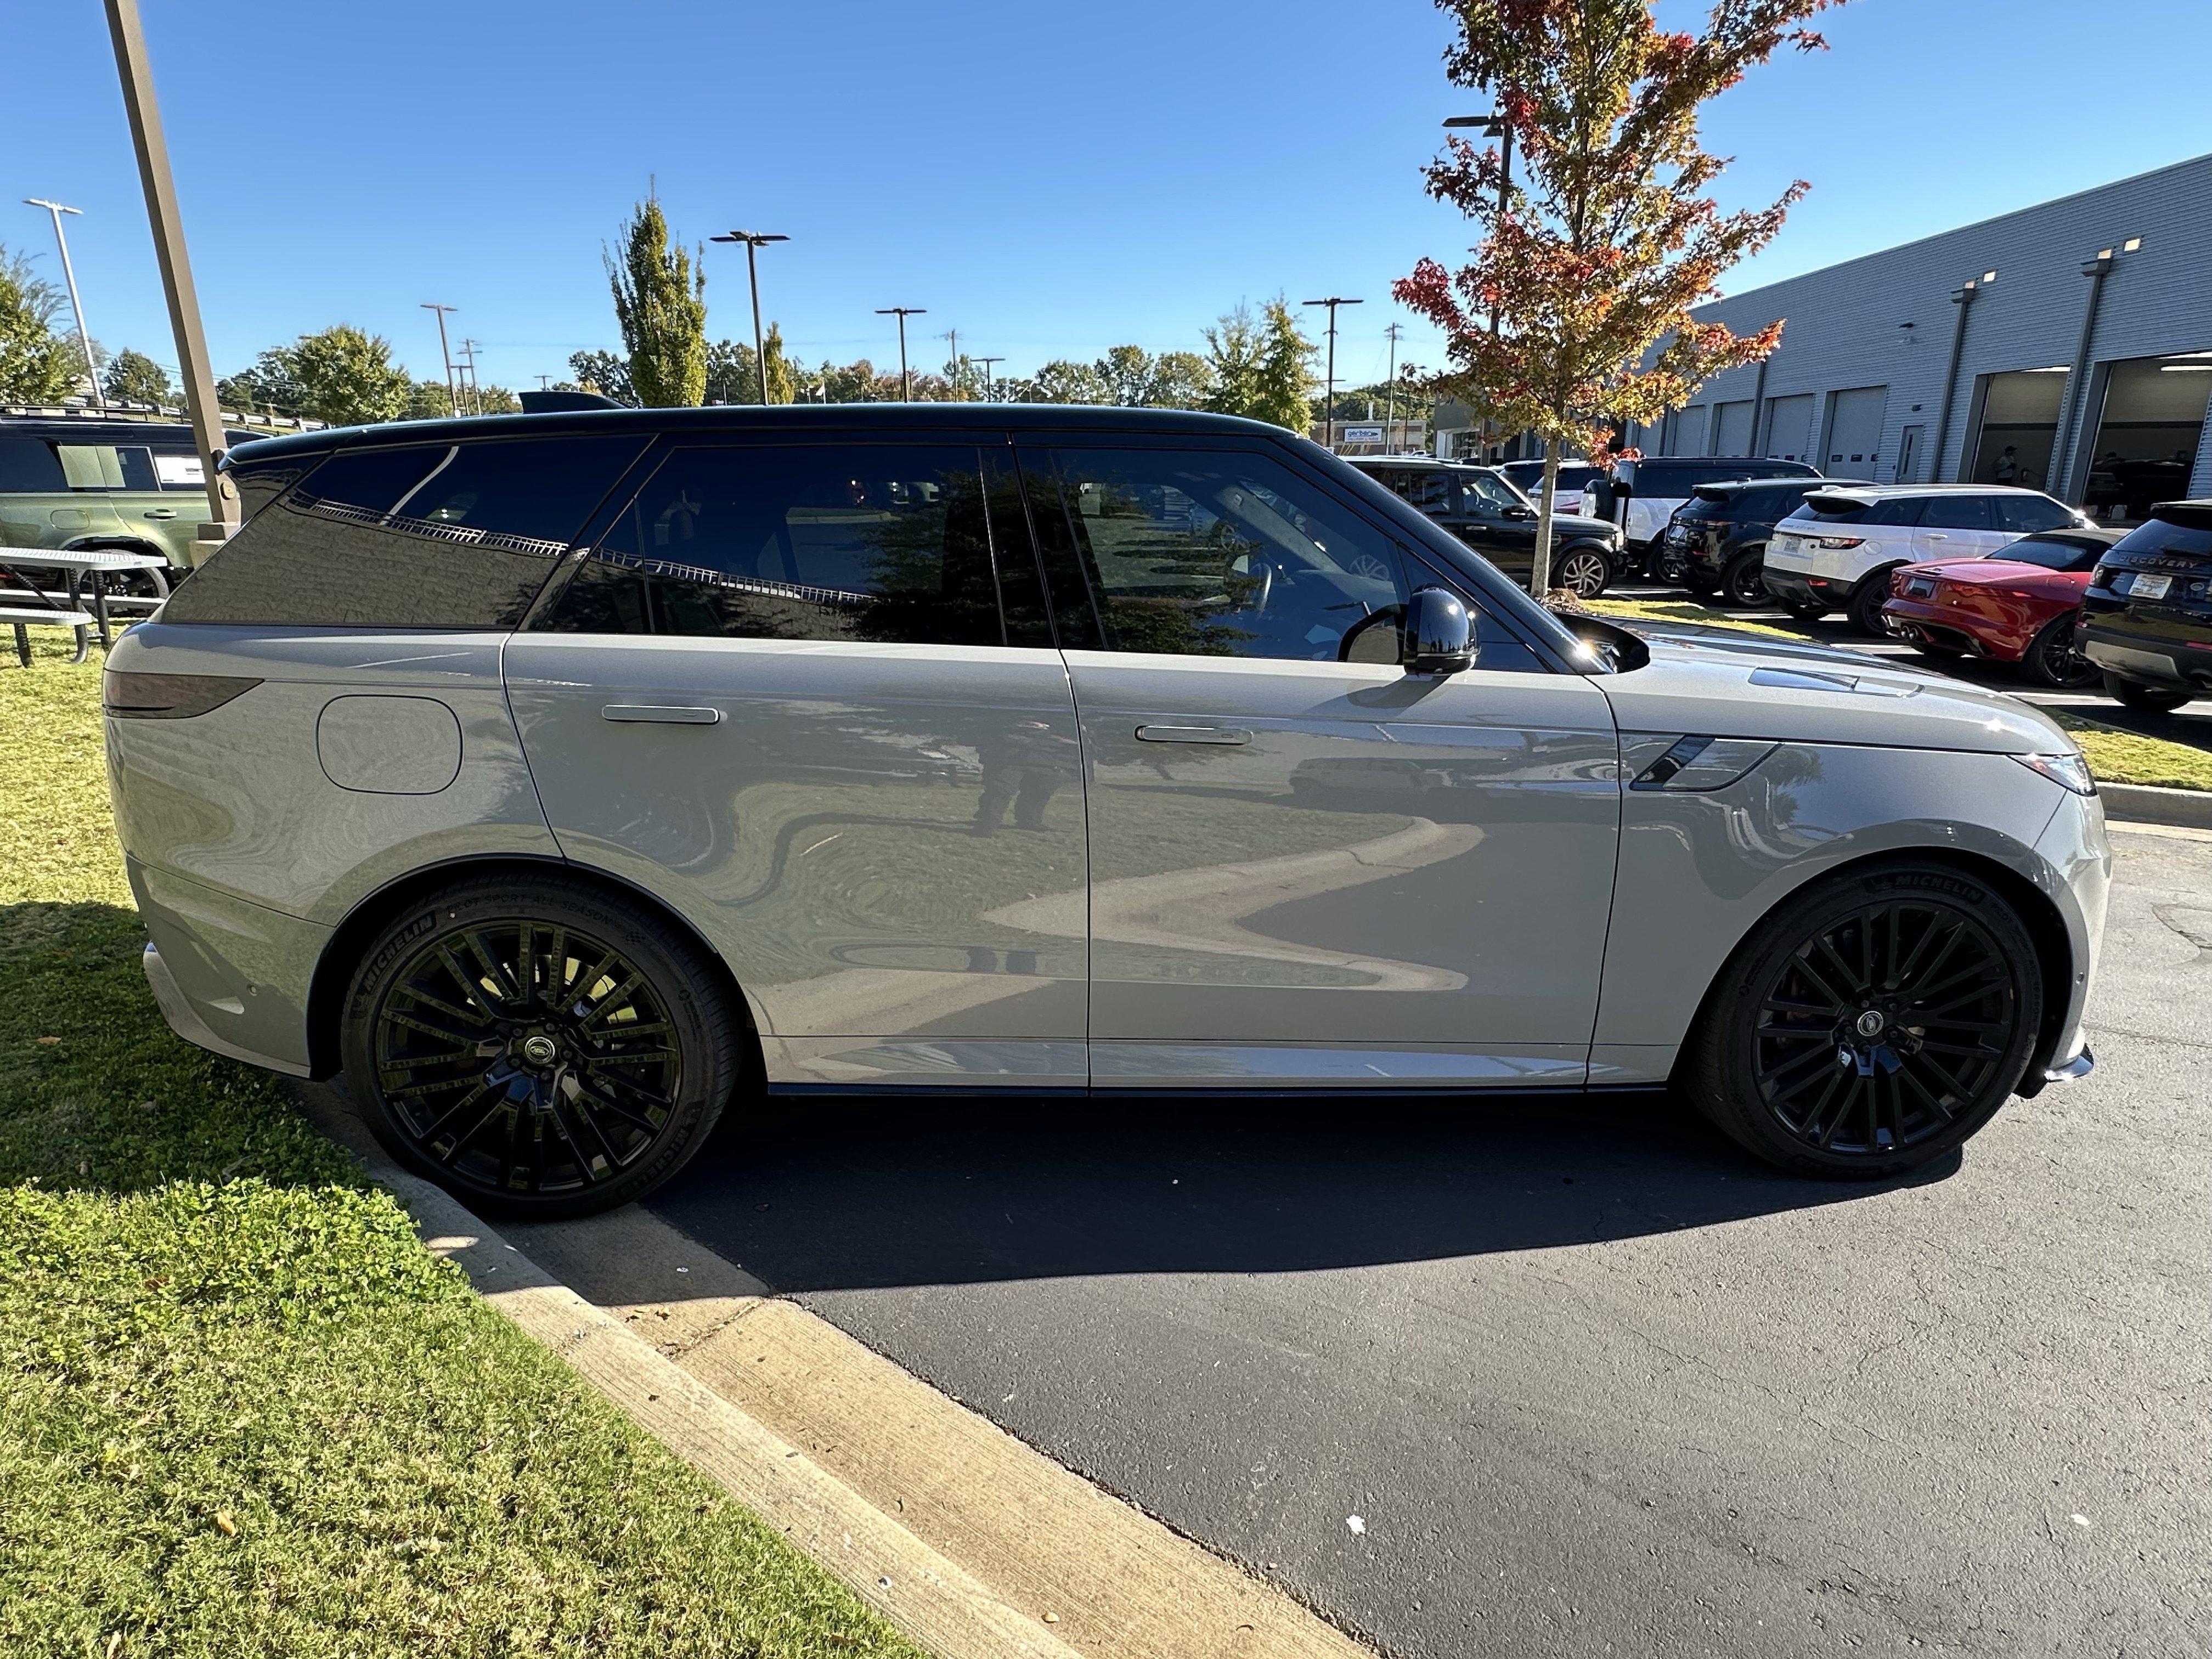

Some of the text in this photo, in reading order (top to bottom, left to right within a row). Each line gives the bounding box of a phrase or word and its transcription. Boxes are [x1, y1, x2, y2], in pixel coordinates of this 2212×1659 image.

[2119, 555, 2198, 569] DISCOVERY
[1894, 875, 1982, 902] MICHELIN
[447, 894, 613, 926] PILOT SPORT ALL SEASON
[363, 915, 433, 991] MICHELIN
[619, 1128, 689, 1197] MICHELIN
